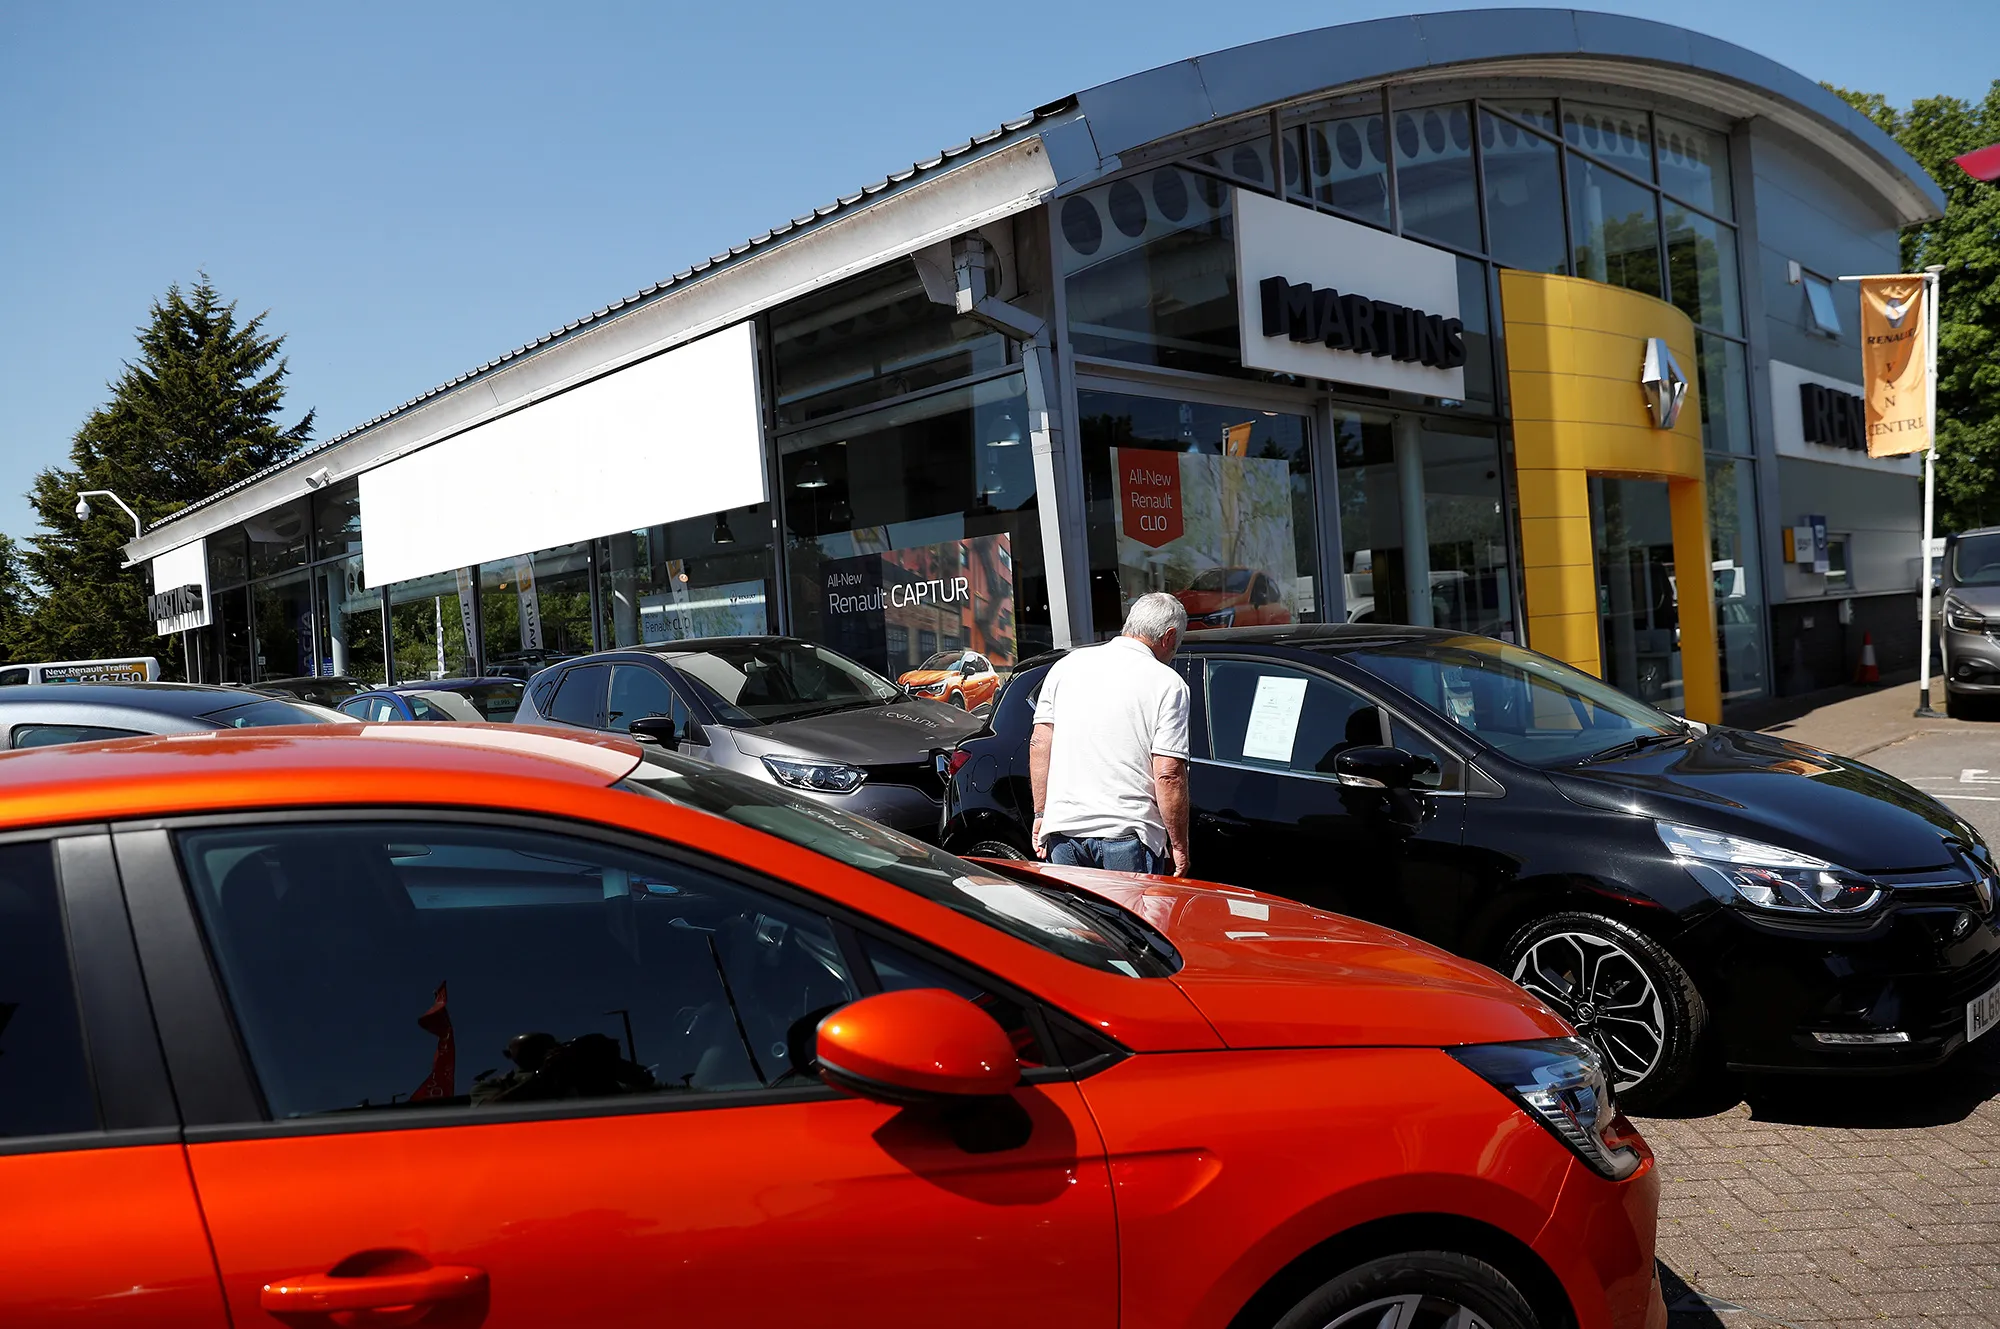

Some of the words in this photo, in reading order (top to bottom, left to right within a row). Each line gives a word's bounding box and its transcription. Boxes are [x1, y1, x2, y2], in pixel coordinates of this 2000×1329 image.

[1260, 276, 1467, 369] MARTINS
[1129, 469, 1171, 486] All-New
[1131, 492, 1173, 509] Renault
[1140, 515, 1167, 531] CLIO
[827, 573, 863, 588] All-New
[148, 584, 203, 621] MARTINS
[828, 587, 888, 614] Renault
[891, 577, 970, 608] CAPTUR
[45, 668, 67, 677] New
[68, 665, 103, 675] Renault
[104, 663, 133, 673] Traffic
